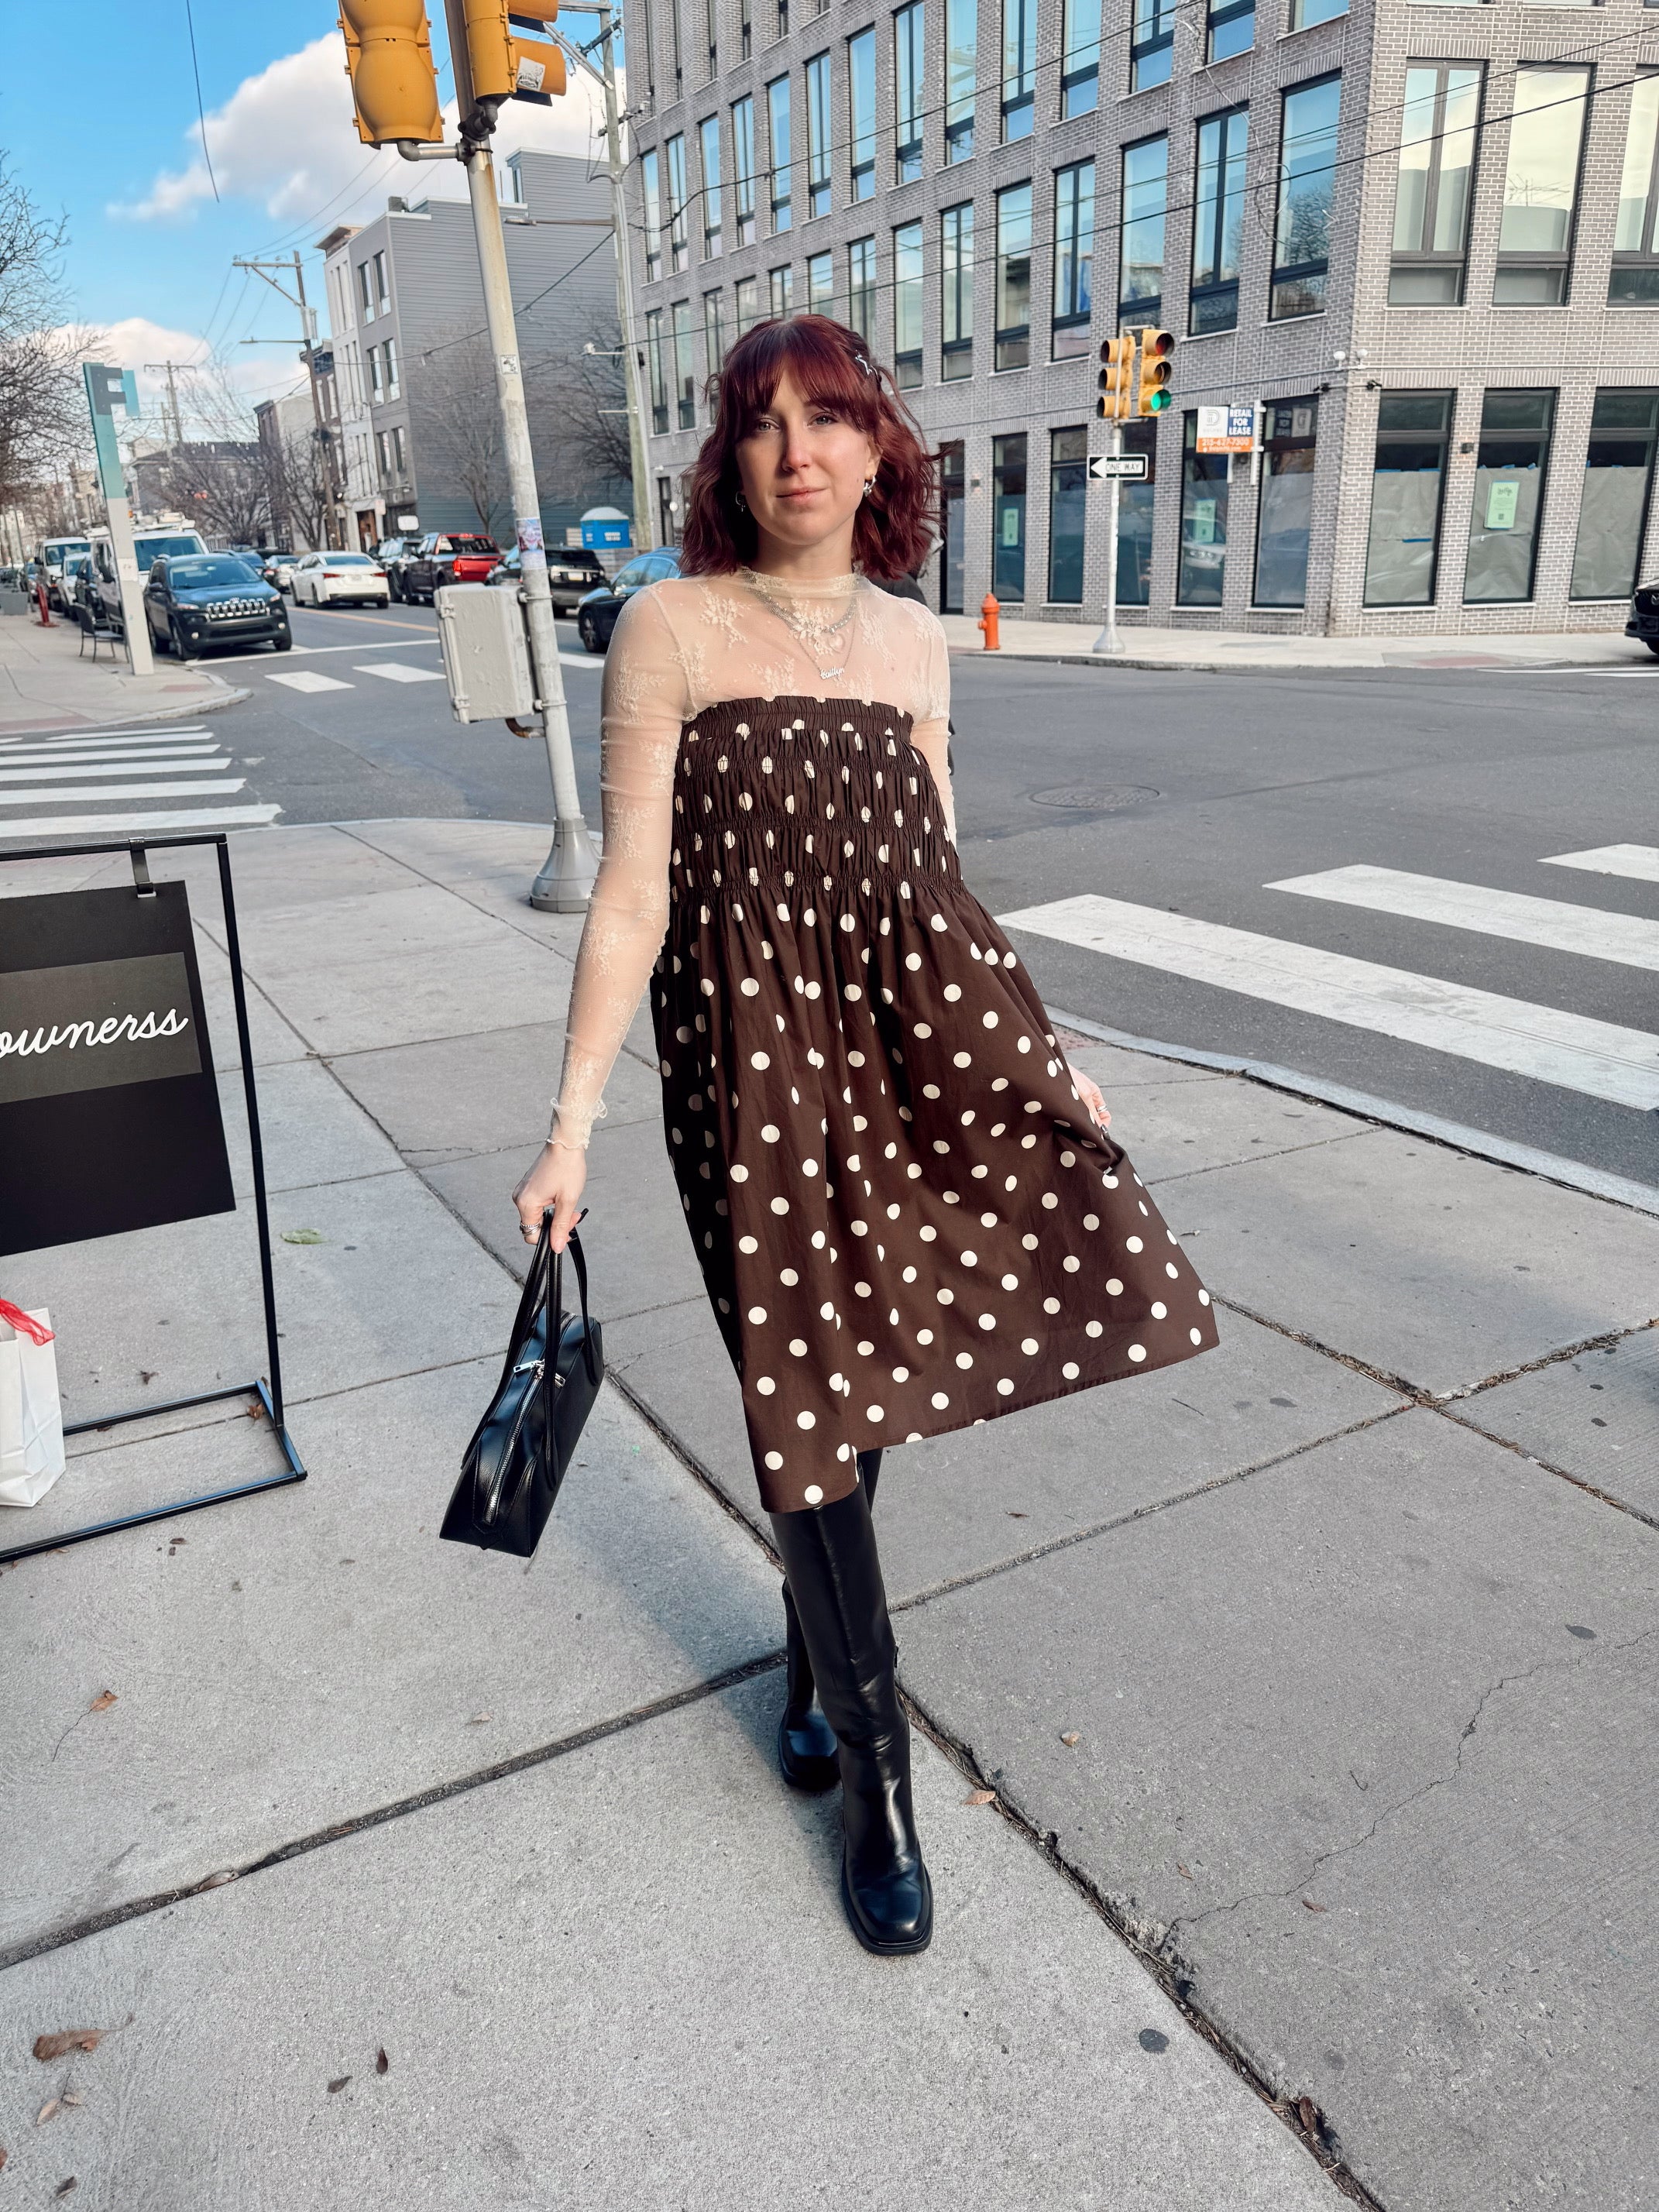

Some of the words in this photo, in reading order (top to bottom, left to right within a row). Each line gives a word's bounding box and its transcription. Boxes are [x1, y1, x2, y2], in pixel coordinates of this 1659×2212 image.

[1229, 409, 1252, 417] RETAIL
[1232, 417, 1249, 426] FOR
[1228, 427, 1252, 435] LEASE
[1105, 463, 1121, 472] ONE
[1124, 463, 1140, 472] WAY
